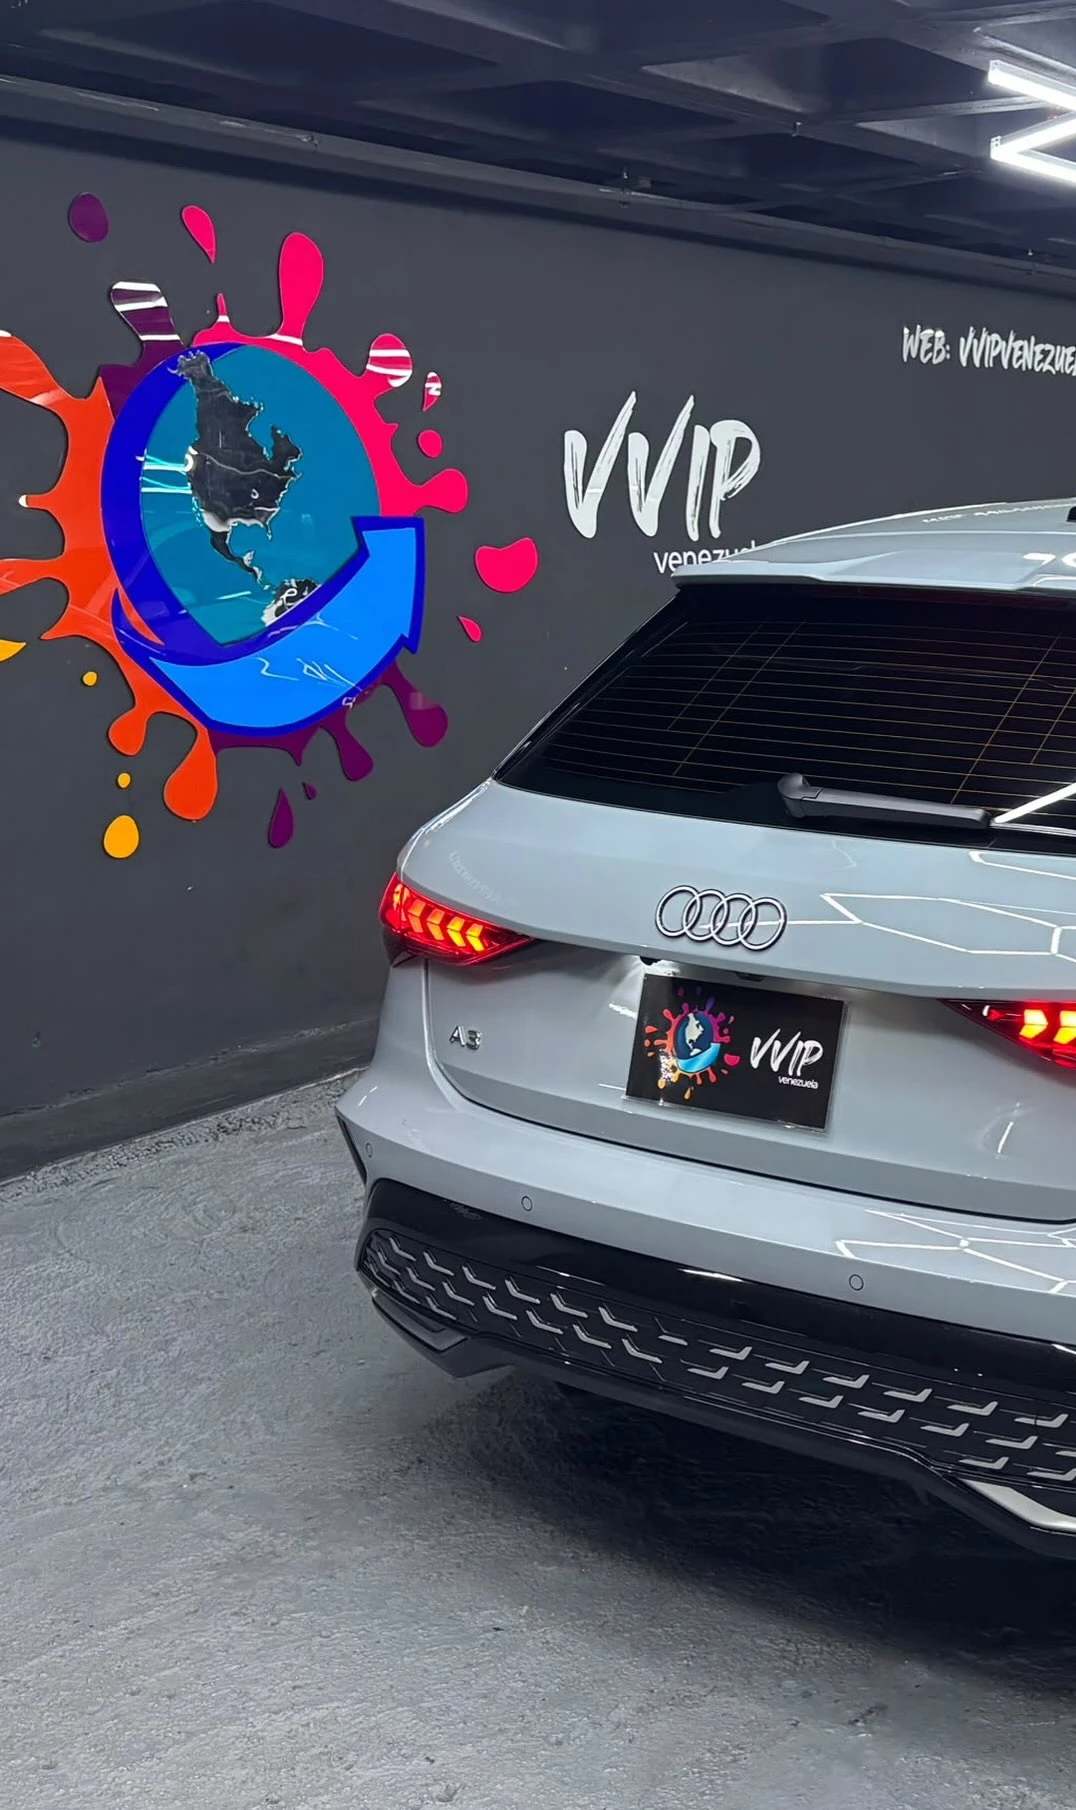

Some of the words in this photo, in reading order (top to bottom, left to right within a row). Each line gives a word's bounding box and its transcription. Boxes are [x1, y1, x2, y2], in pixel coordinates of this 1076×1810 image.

[902, 324, 950, 365] WEB:
[564, 390, 761, 541] VVIP
[449, 1025, 481, 1051] A3
[750, 1028, 824, 1077] VVIP
[778, 1076, 819, 1089] venezuela
